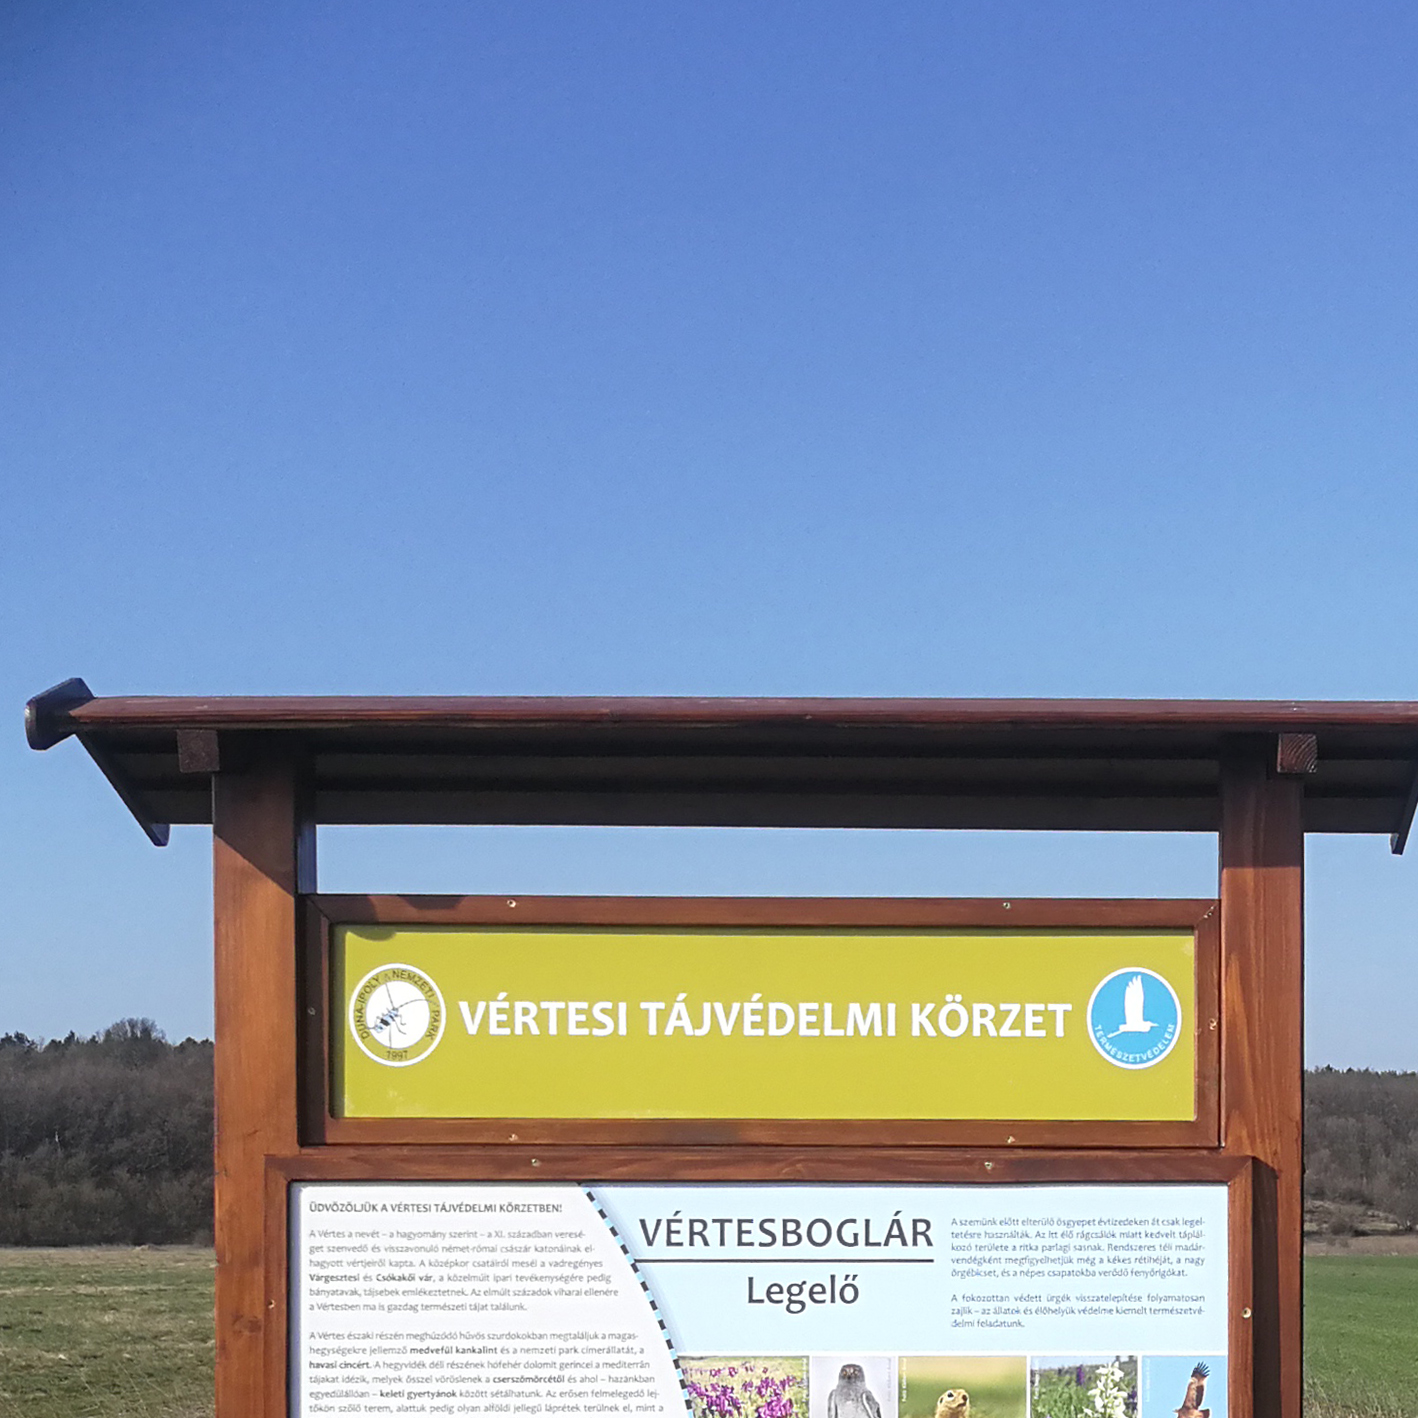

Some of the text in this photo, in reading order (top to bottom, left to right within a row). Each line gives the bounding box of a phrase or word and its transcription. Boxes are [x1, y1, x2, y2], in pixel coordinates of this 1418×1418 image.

[355, 970, 440, 1040] DUNA-IPOLY NEMZETI PARK
[458, 991, 1073, 1038] VÉRTESI TÁJVÉDELMI KÖRZET
[1094, 1024, 1175, 1062] TERMÉSZETVÉDELEM
[309, 1202, 562, 1212] ÜDVÖZÖLJÜK A VÉRTESI TÁJVÉDELMI KÖRZETBEN!
[639, 1210, 933, 1247] VÉRTESBOGLÁR
[748, 1274, 859, 1314] Legelő
